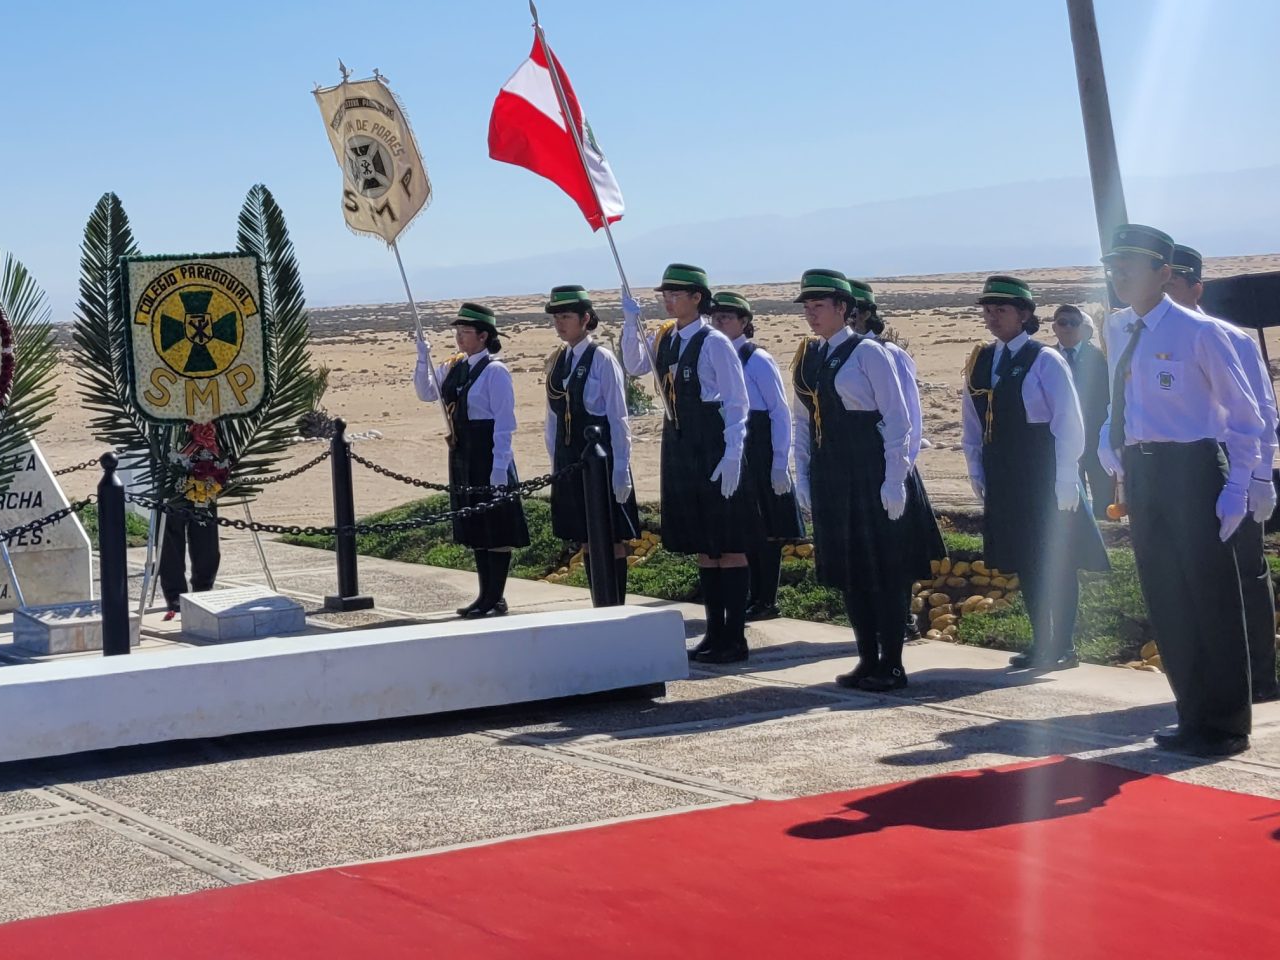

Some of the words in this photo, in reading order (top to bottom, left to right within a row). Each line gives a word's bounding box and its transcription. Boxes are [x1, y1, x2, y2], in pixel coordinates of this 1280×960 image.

[355, 119, 368, 131] DE
[138, 272, 178, 316] COLEGIO
[179, 265, 251, 307] PARROQUIAL
